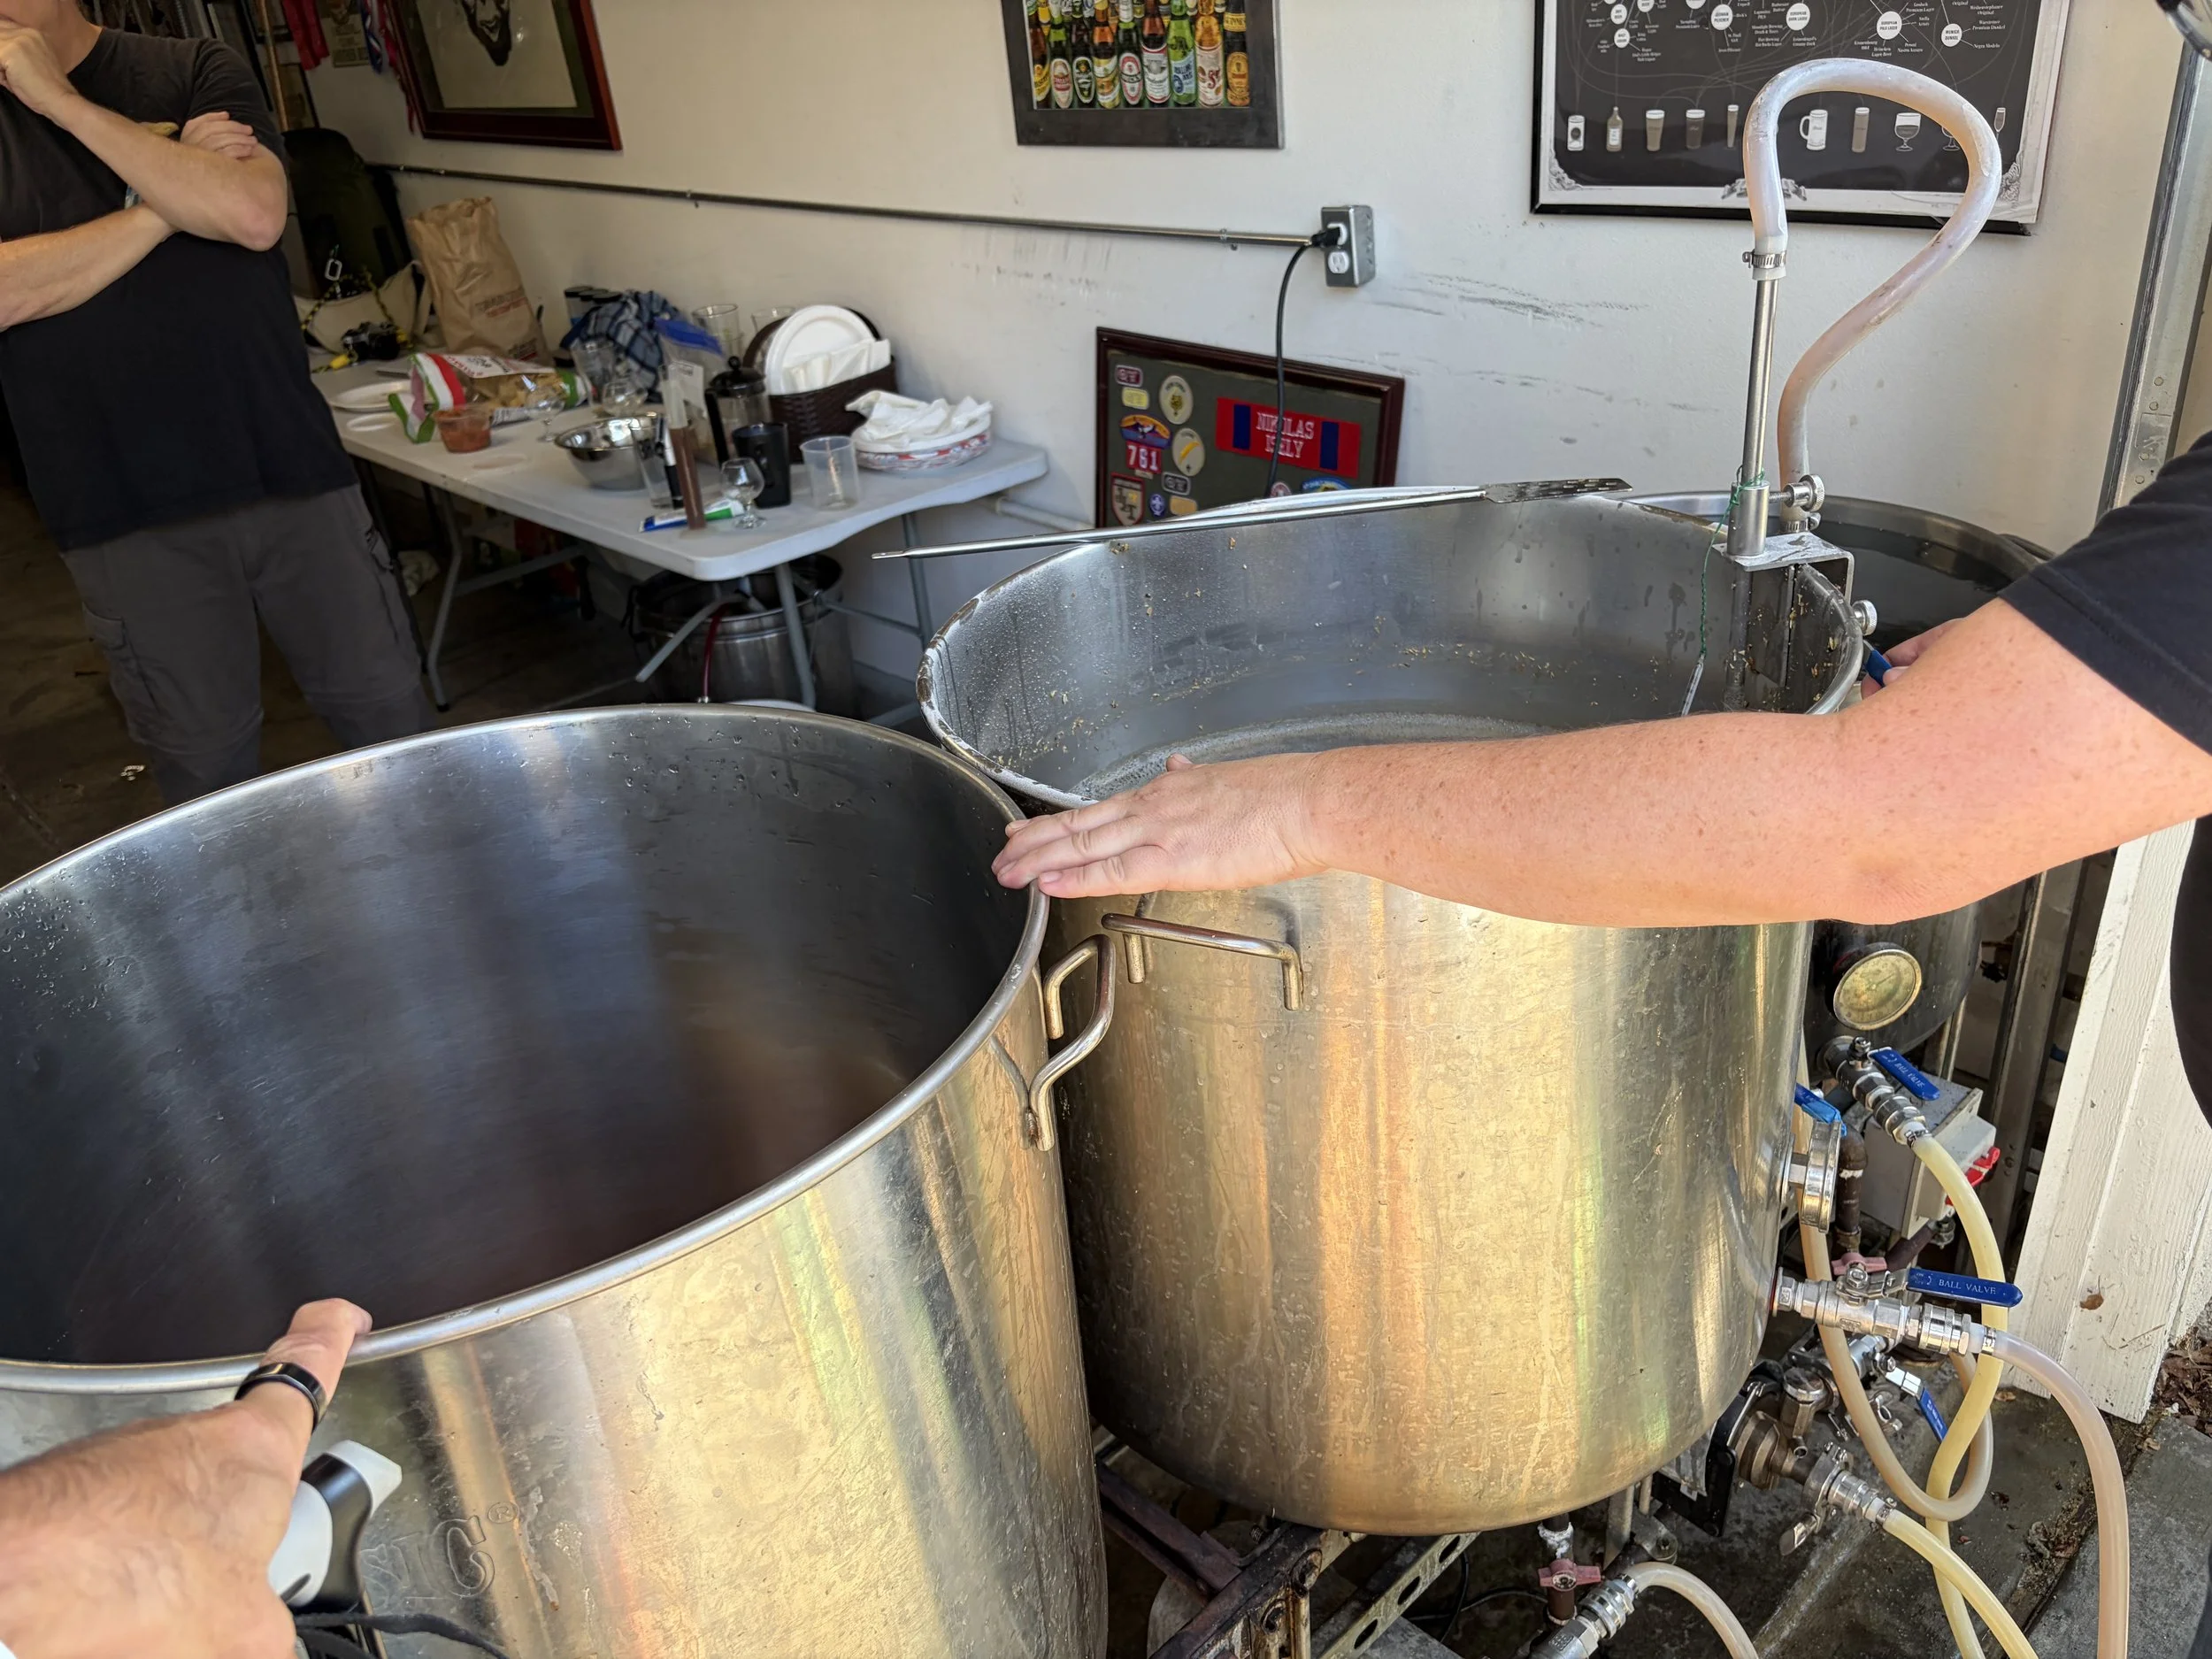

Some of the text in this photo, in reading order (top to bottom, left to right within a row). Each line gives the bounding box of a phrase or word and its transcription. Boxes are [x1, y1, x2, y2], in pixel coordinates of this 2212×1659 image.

[1256, 411, 1315, 440] NIKLAS
[1127, 444, 1159, 472] 761
[1939, 1279, 1996, 1294] BALL VALVE
